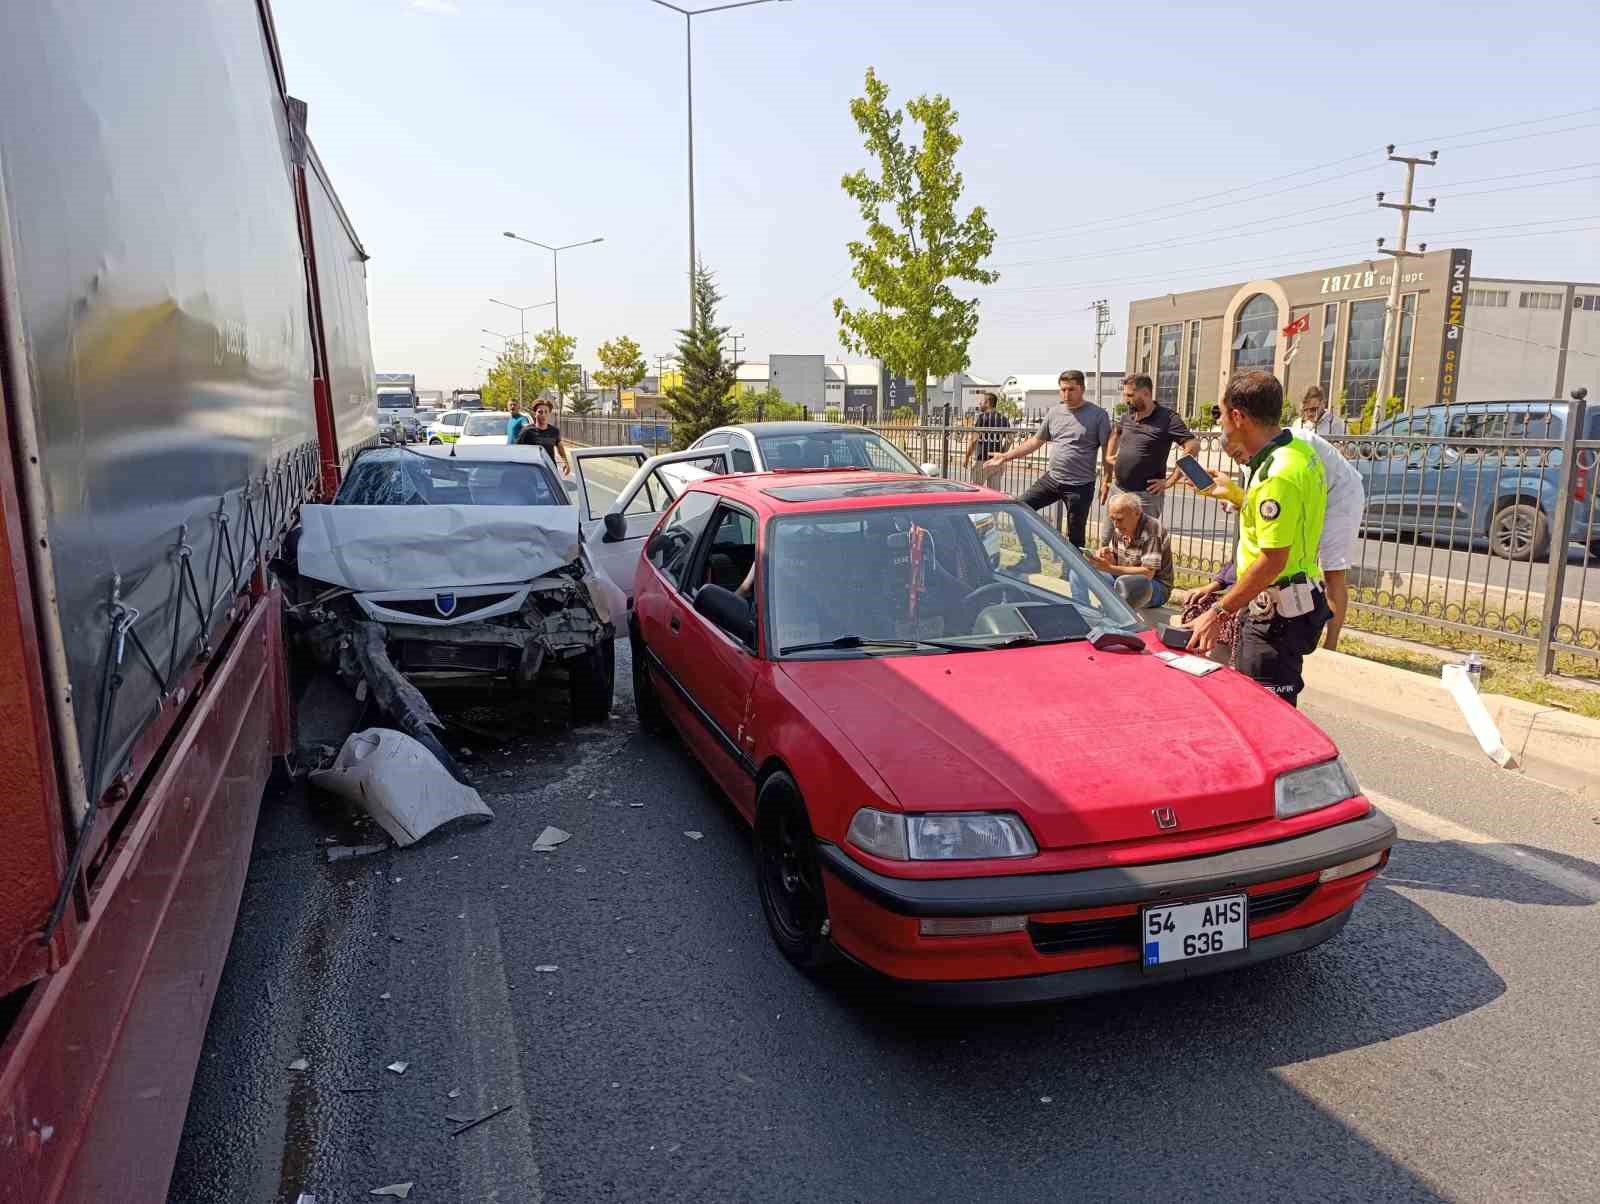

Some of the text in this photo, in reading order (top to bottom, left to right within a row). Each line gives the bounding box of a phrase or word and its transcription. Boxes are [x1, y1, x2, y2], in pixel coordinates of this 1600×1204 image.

[1379, 272, 1424, 286] Cocept
[1149, 902, 1241, 935] 54 AHS
[1184, 931, 1224, 956] 636
